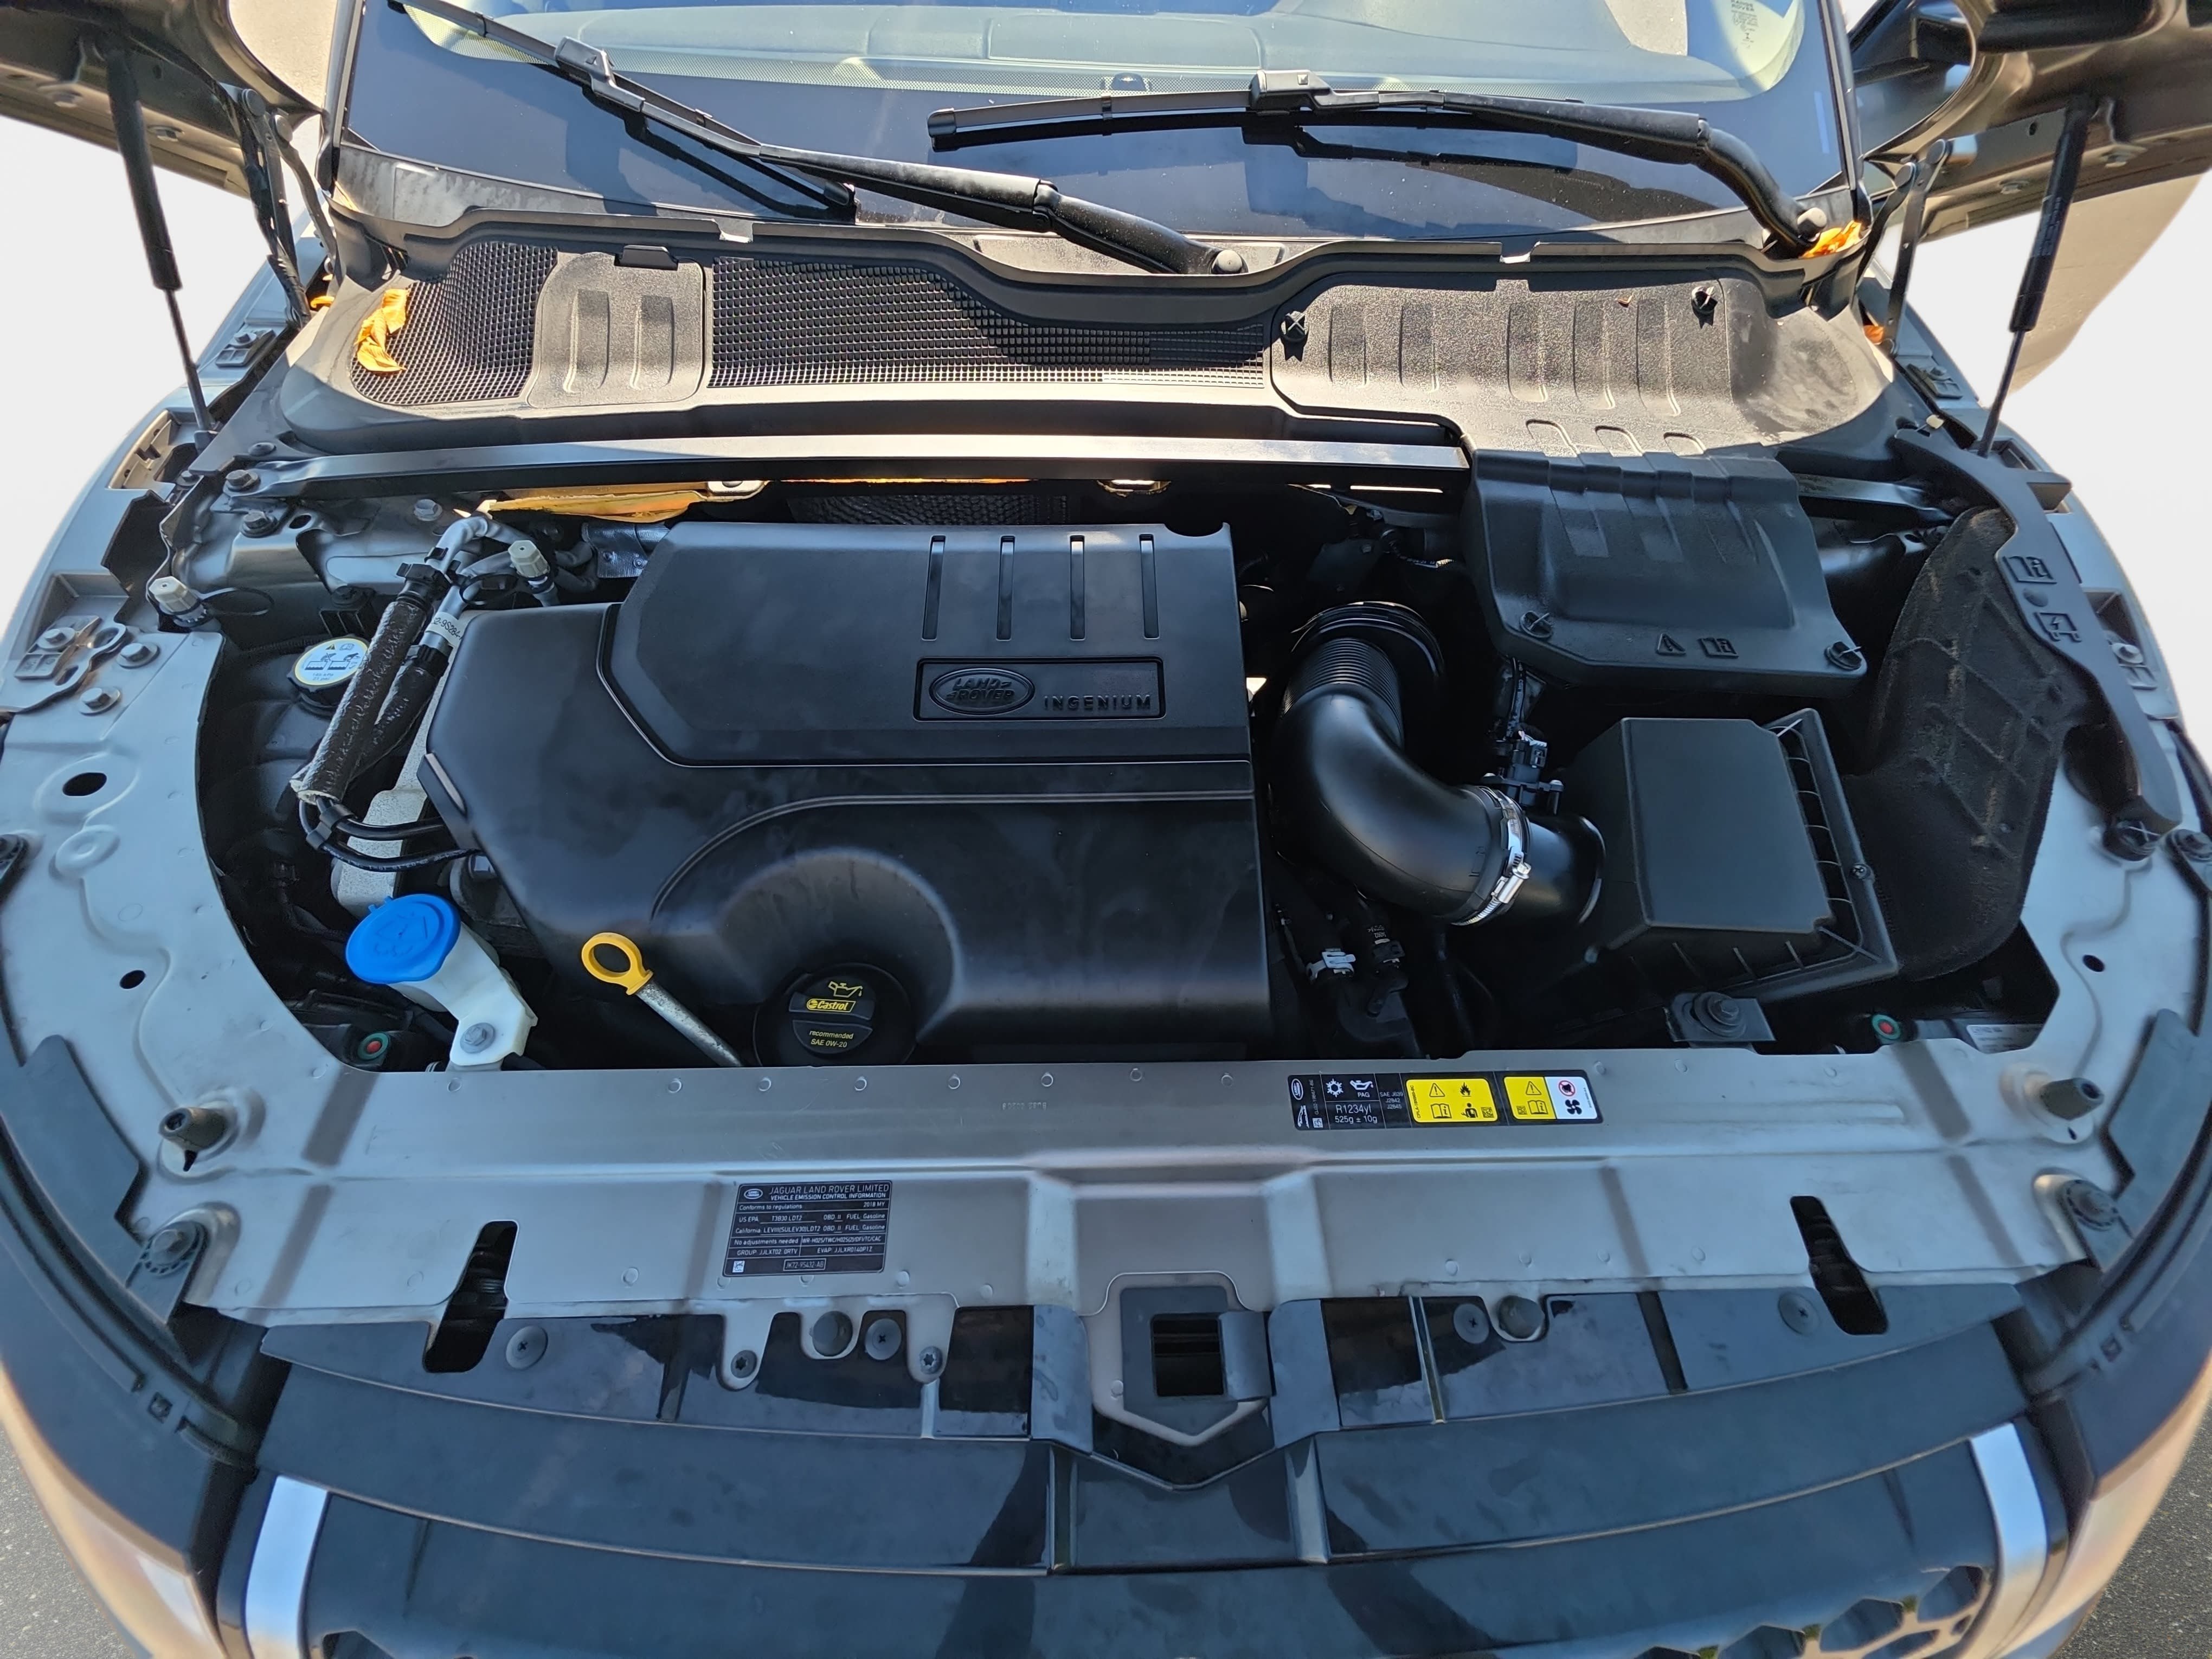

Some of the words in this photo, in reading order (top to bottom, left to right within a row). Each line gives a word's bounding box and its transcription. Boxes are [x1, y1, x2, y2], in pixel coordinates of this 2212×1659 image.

[953, 678, 1001, 690] LAND
[956, 689, 1015, 701] ROVER
[1045, 694, 1151, 711] INGENIUM
[818, 1000, 848, 1010] Castrol
[809, 1030, 854, 1039] recommended
[1335, 1116, 1354, 1124] 525g
[1364, 1115, 1378, 1124] 10g
[769, 1185, 802, 1195] JAGUAR
[803, 1185, 826, 1193] LAND
[828, 1184, 855, 1193] ROVER
[857, 1184, 889, 1192] LIMITED
